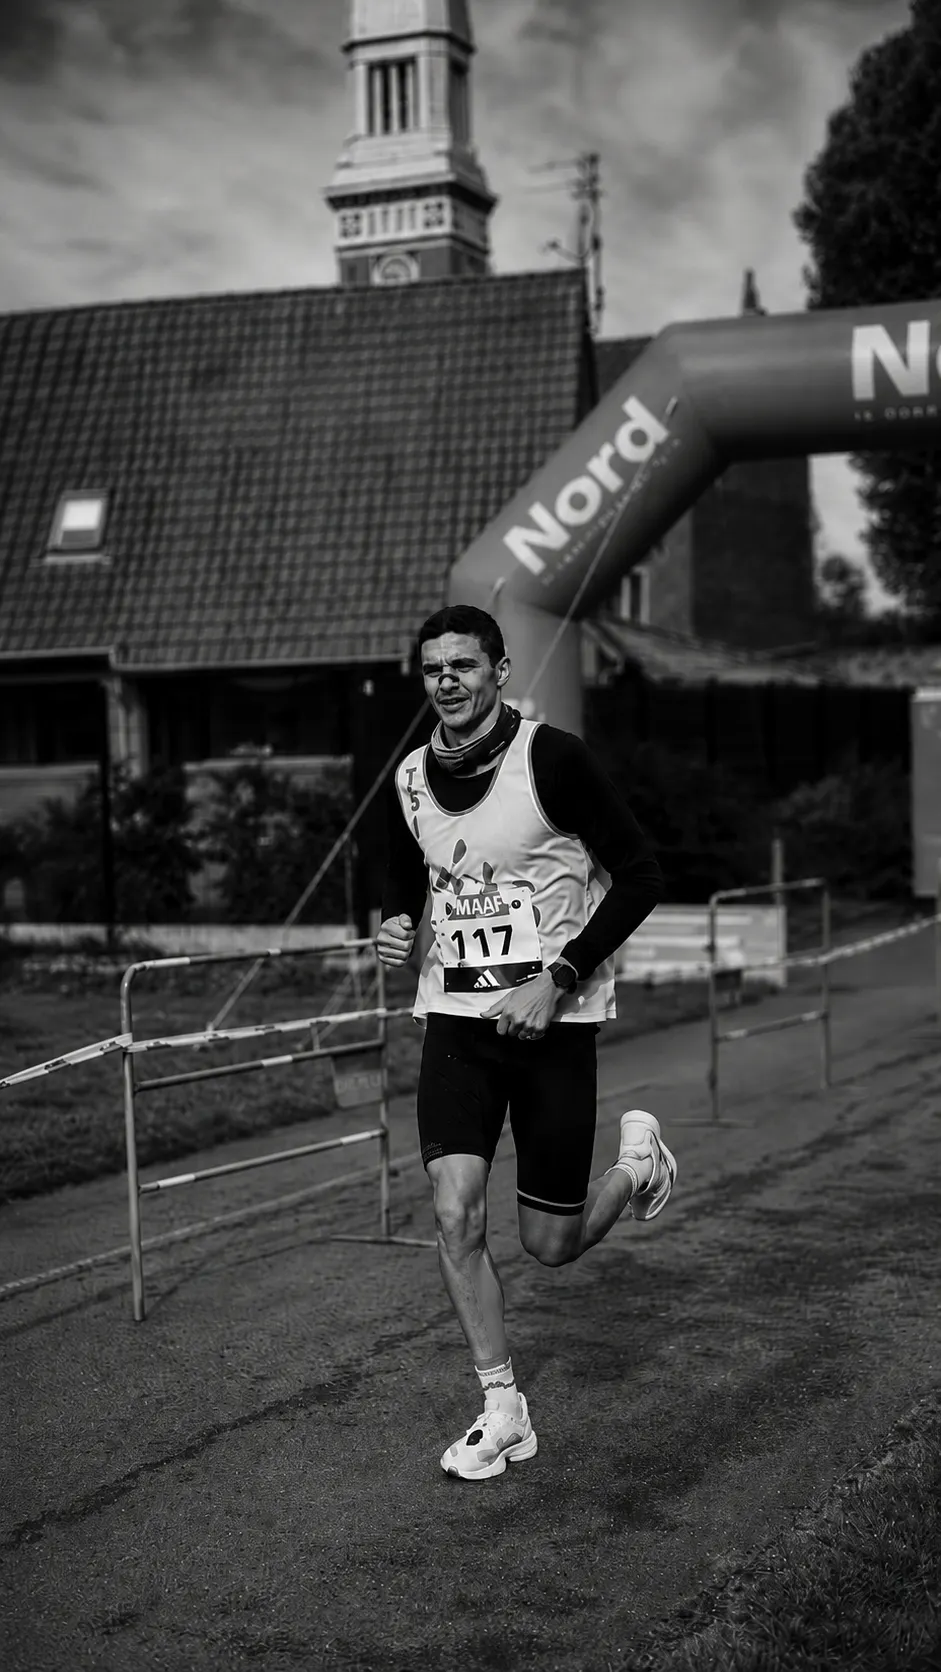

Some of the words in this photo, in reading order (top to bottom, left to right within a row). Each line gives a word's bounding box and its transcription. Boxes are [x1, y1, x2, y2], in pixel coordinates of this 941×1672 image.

[852, 319, 941, 401] N
[502, 394, 669, 576] Nord
[456, 895, 503, 916] MAAF
[451, 924, 513, 960] 117
